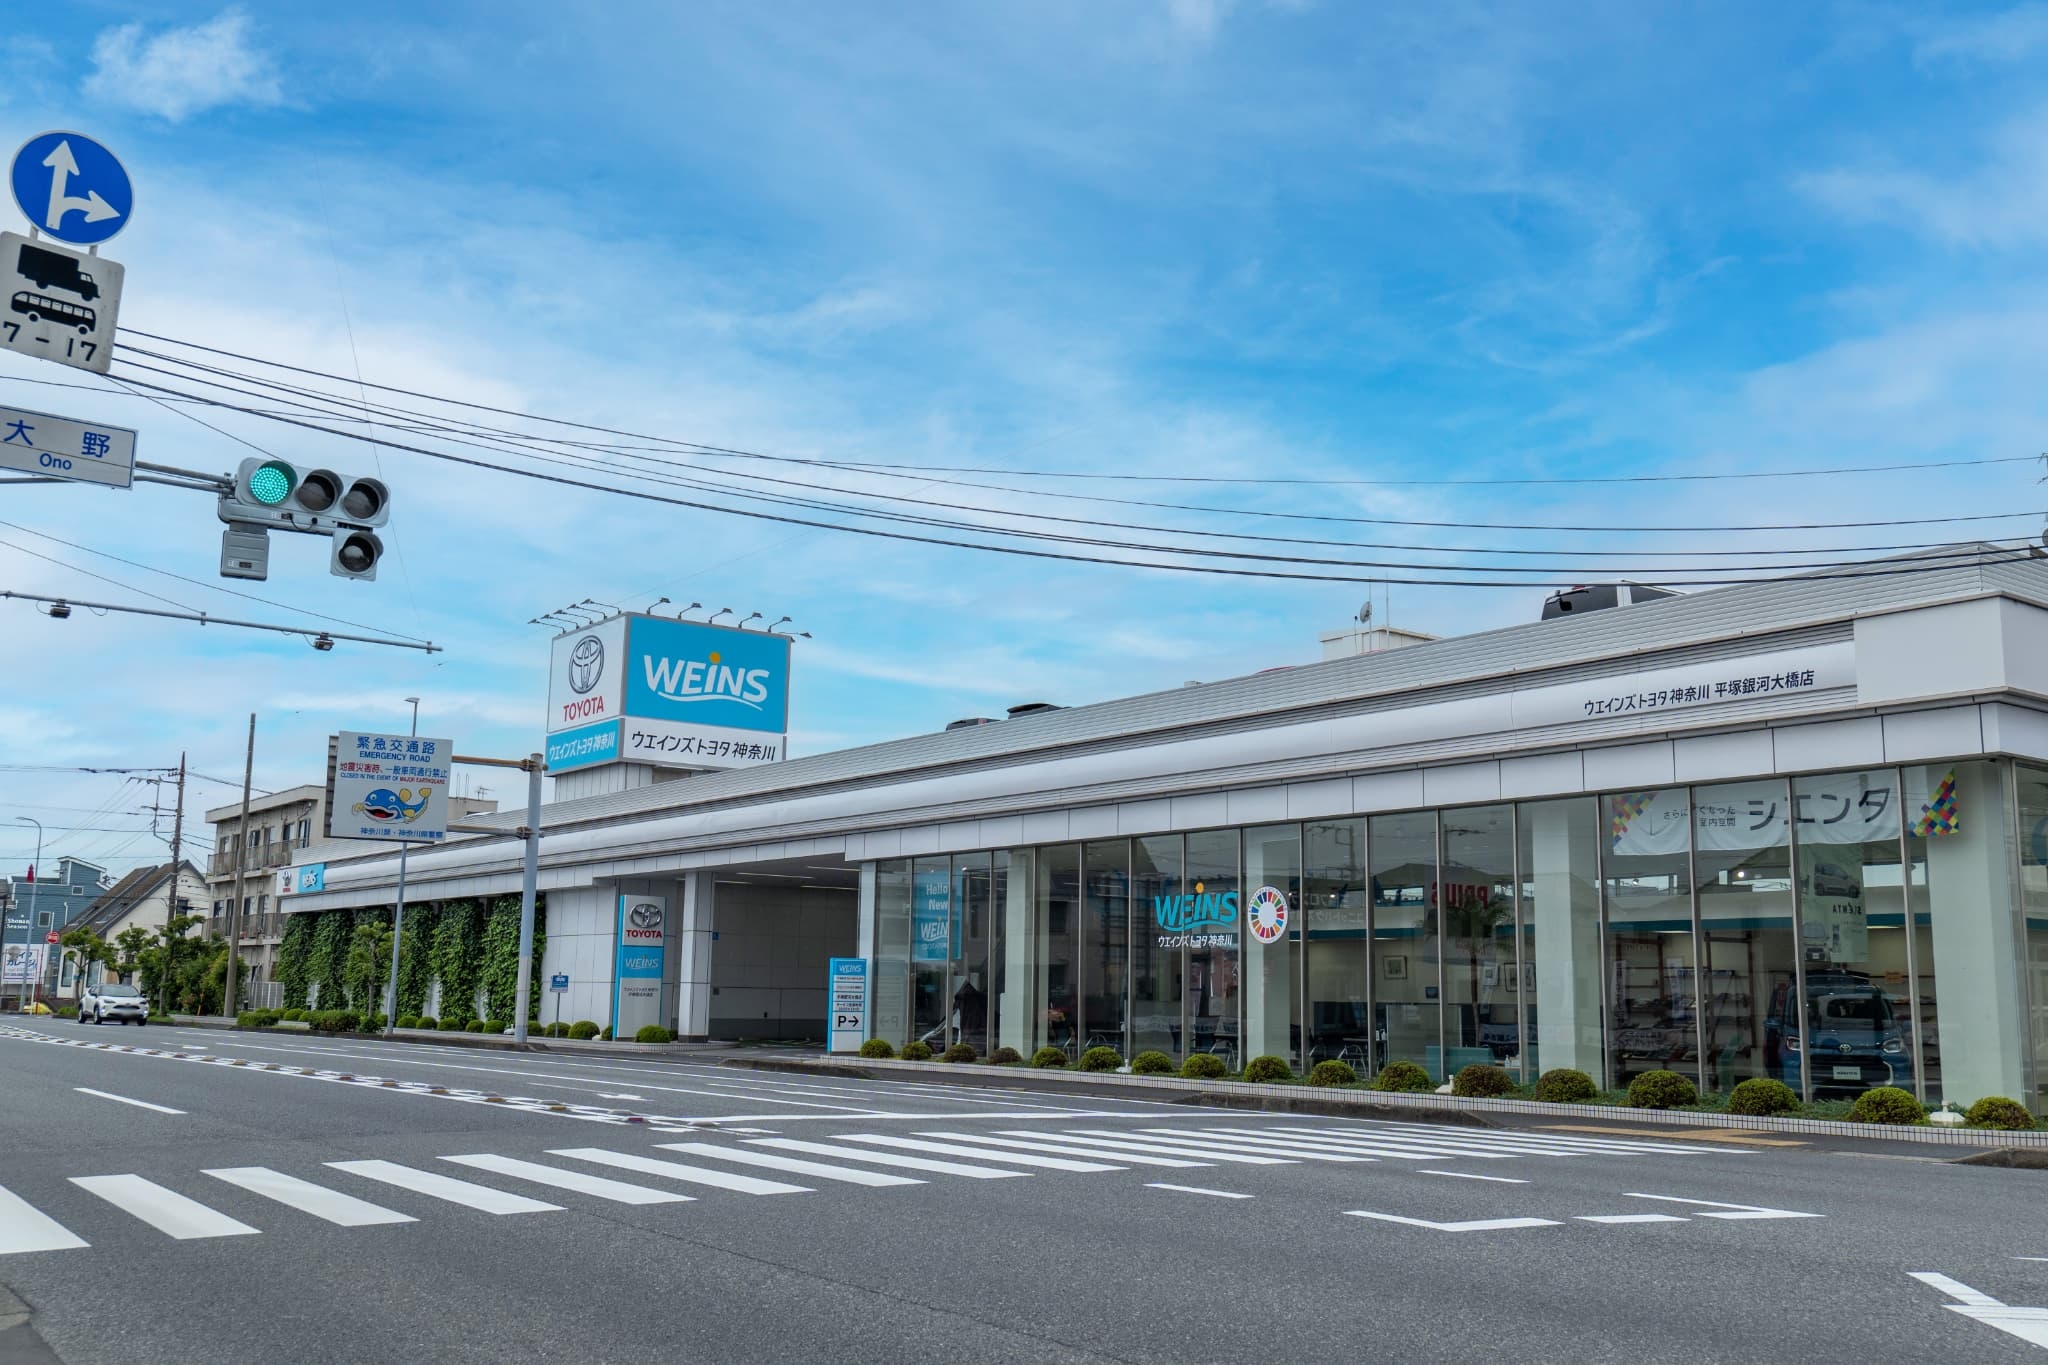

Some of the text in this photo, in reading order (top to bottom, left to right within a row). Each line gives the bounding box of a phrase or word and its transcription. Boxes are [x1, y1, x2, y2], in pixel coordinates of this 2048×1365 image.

[39, 453, 72, 470] Ono
[1714, 670, 1815, 698] 平塚銀河大橋店
[563, 696, 604, 722] TOYOTA
[356, 736, 436, 755] 緊急交通路
[359, 751, 431, 763] EMERGENCY ROAD
[1664, 805, 1736, 820] さらにくなった
[1748, 788, 1890, 831] シエンタ
[926, 883, 948, 896] Hello
[928, 899, 948, 910] New
[626, 929, 662, 938] TOYOTA
[838, 1016, 847, 1027] P
